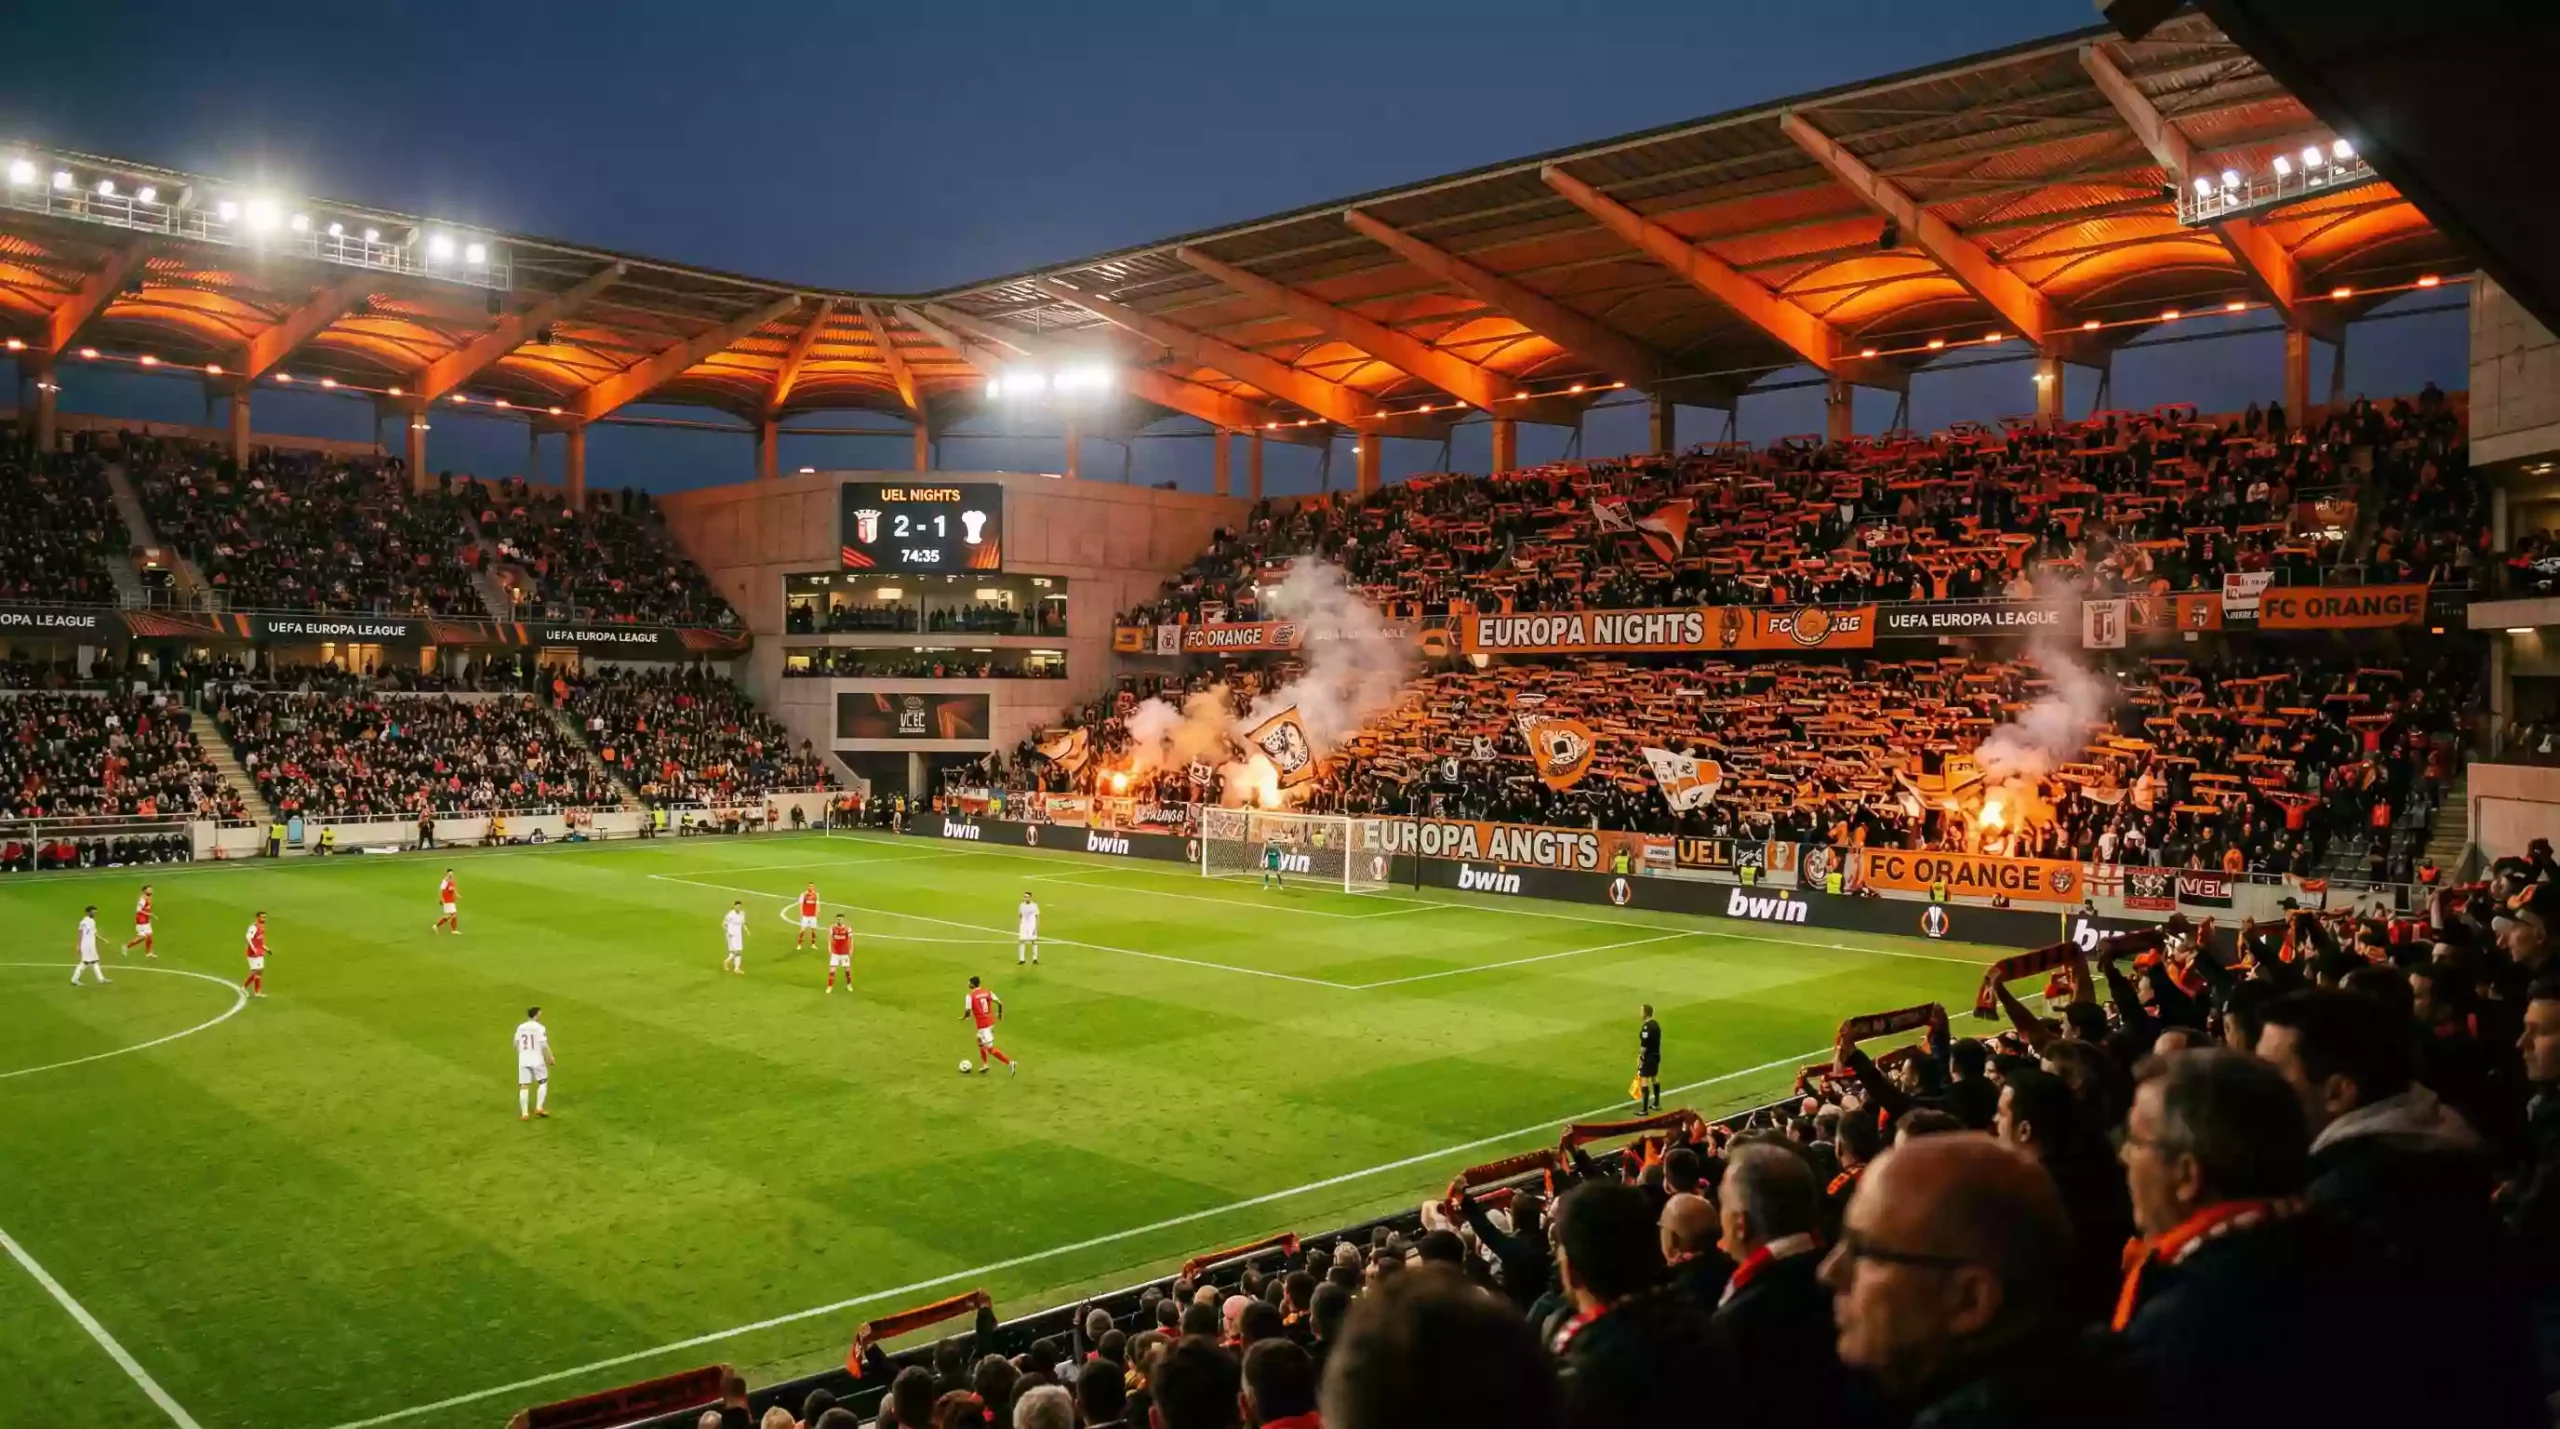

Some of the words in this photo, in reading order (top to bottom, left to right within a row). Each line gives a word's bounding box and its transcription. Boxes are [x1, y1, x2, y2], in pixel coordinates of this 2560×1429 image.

[882, 489, 907, 501] UEL
[911, 489, 961, 502] NIGHTS
[894, 515, 910, 537] 2
[933, 515, 946, 537] 1
[902, 549, 940, 563] 74:35
[2265, 598, 2297, 619] FC
[2305, 594, 2419, 618] ORANGE
[0, 613, 32, 625] OPA
[36, 614, 96, 628] LEAGUE
[268, 621, 303, 634] UEFA
[306, 622, 356, 635] EUROPA
[358, 624, 406, 637] LEAGUE
[1478, 616, 1586, 646] EUROPA
[1594, 612, 1705, 645] NIGHTS
[1769, 618, 1791, 633] FC
[1889, 614, 1928, 628] UEFA
[1932, 613, 1993, 627] EUROPA
[1996, 611, 2060, 626] LEAGUE
[546, 630, 575, 641] UEFA
[576, 631, 617, 642] EUROPA
[619, 632, 658, 643] LEAGUE
[1187, 630, 1203, 647] FC
[1207, 628, 1262, 647] ORANGE
[943, 818, 980, 840] bwin
[1087, 830, 1129, 855] bwin
[1364, 817, 1480, 860] EUROPA
[1488, 827, 1599, 869] ANGTS
[1678, 839, 1729, 864] UEL
[1458, 863, 1521, 893] bwin
[1870, 855, 1905, 881] FC
[1914, 858, 2041, 891] ORANGE
[1727, 888, 1808, 922] bwin
